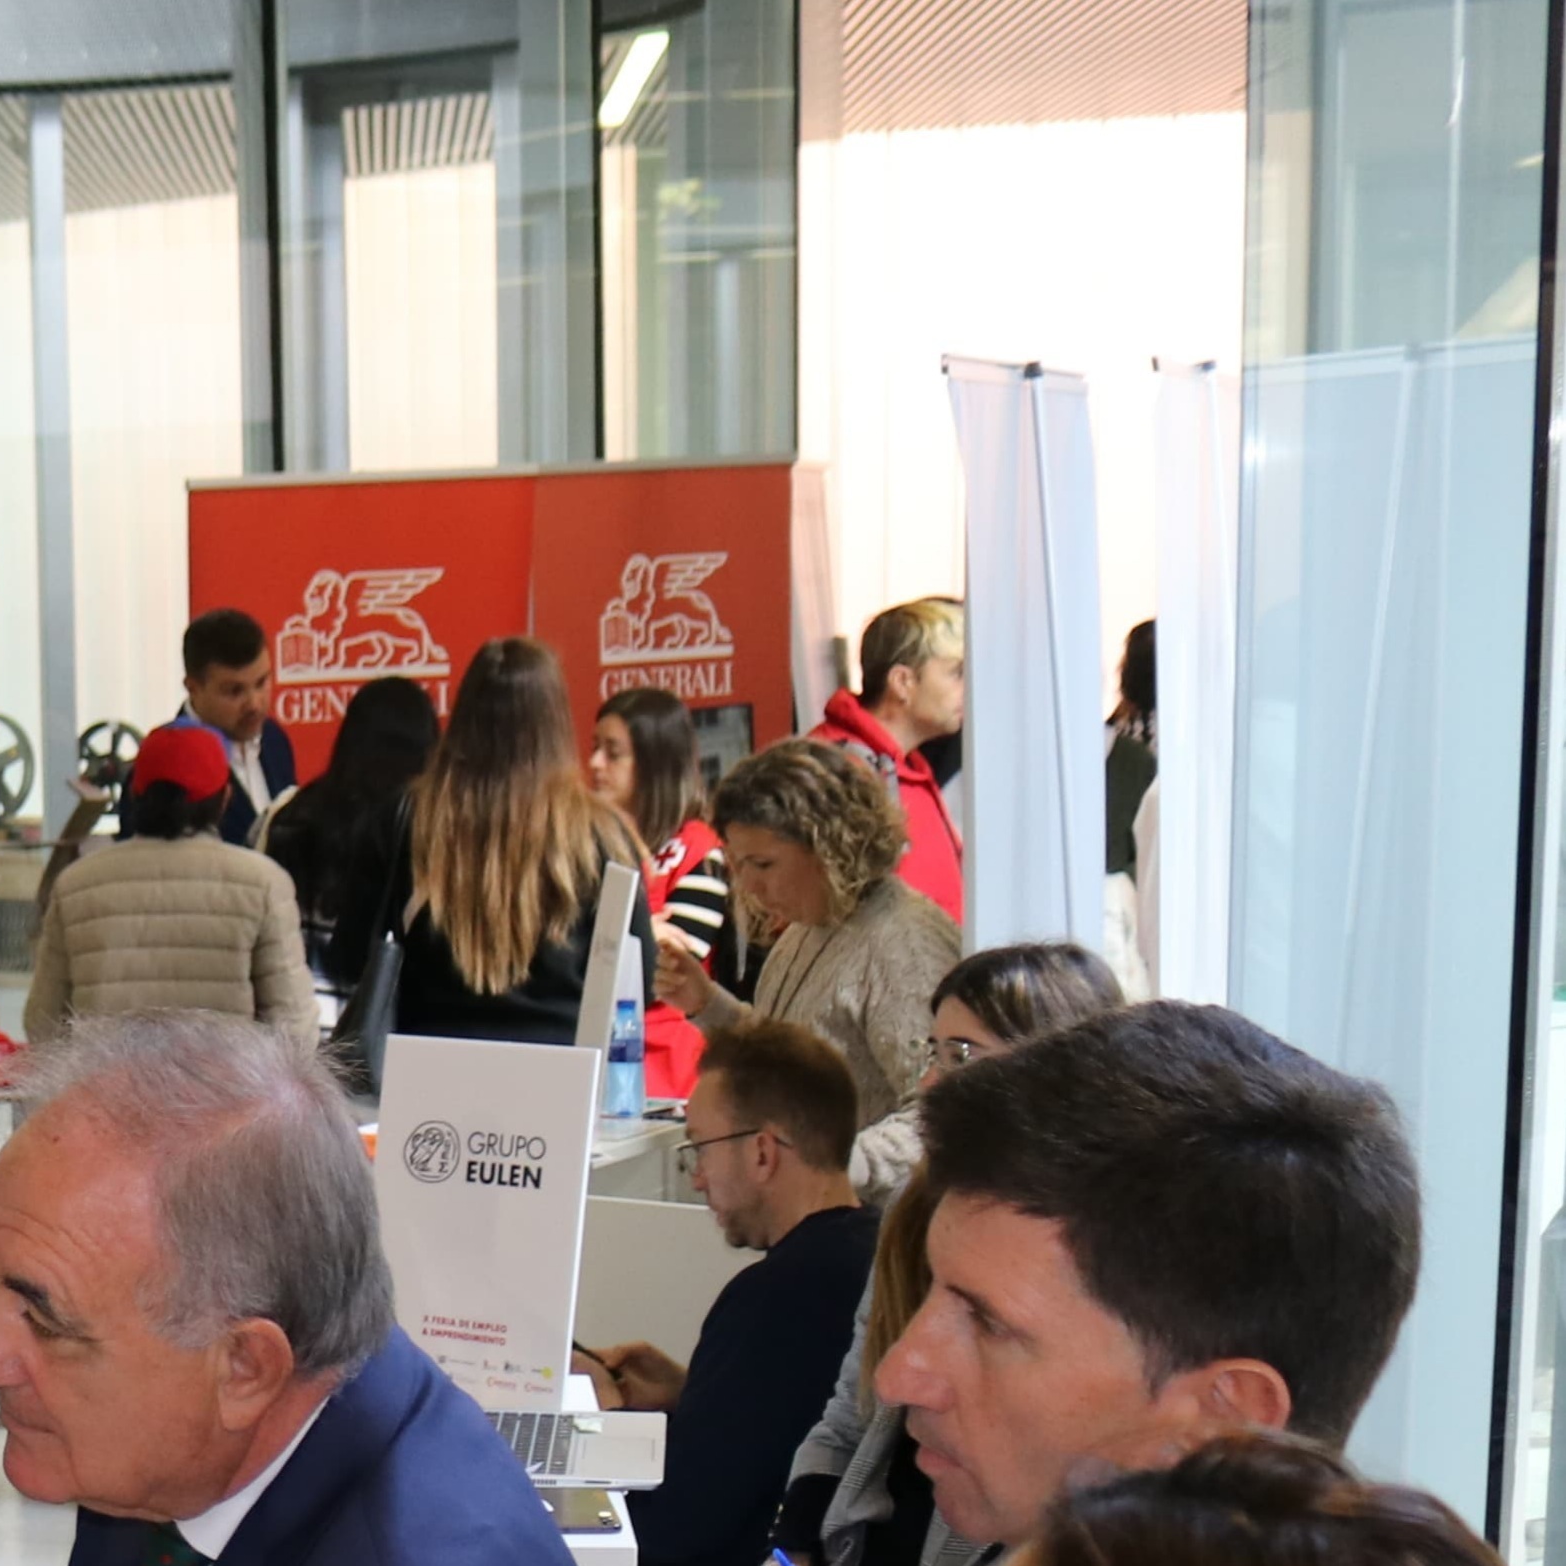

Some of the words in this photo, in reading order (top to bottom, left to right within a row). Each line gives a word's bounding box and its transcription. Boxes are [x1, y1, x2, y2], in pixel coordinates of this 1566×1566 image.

[599, 661, 734, 702] GENERALI
[275, 681, 451, 724] GENI
[467, 1131, 547, 1160] GRUPO
[466, 1160, 542, 1189] EULEN
[430, 1329, 506, 1346] EMPRENDIMIENTO
[432, 1316, 456, 1327] FERIA
[458, 1320, 469, 1328] DE
[472, 1321, 508, 1333] EMPLEO
